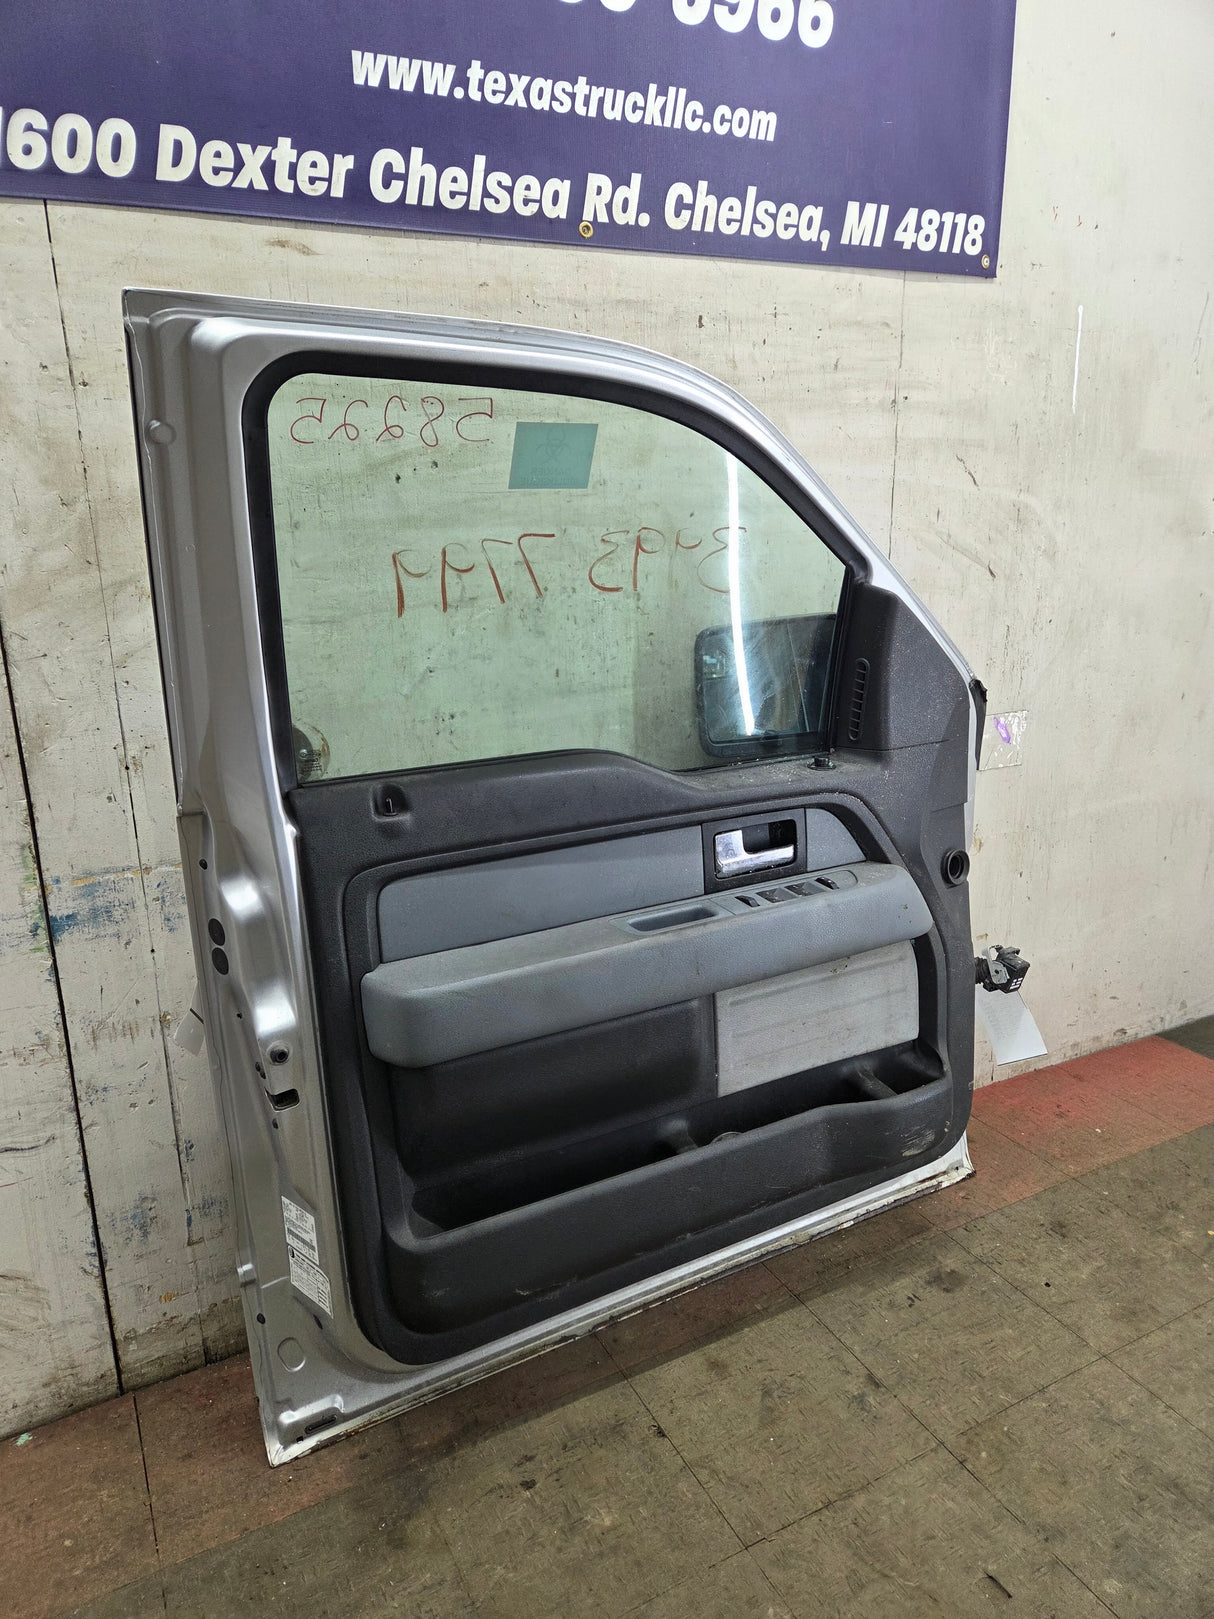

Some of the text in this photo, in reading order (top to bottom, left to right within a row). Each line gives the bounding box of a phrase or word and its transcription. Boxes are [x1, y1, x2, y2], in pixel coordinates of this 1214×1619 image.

[351, 49, 778, 143] www.texastruckllc.com
[0, 106, 986, 256] 600 Dexter Chelsea Rd. Chelsea, MI 48118
